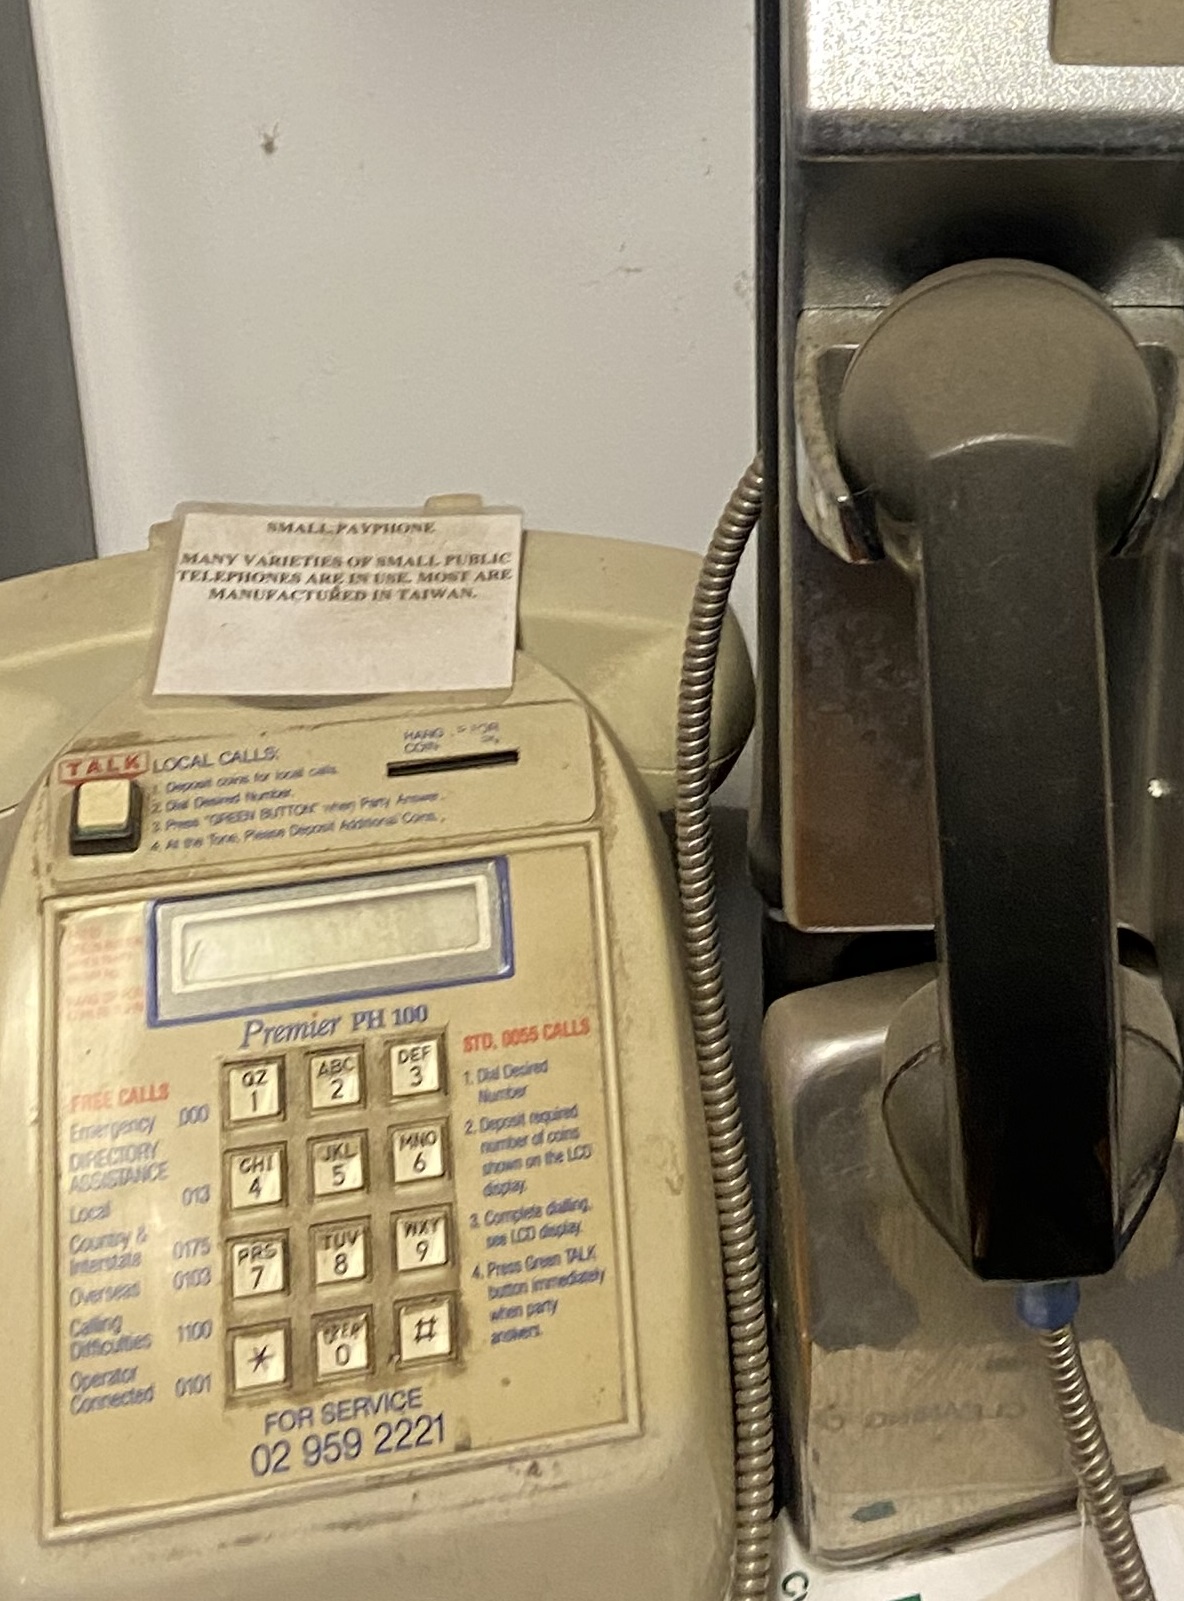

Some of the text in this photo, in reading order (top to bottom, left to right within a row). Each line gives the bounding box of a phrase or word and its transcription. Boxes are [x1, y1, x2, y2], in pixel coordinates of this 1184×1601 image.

[267, 520, 436, 535] SMALL PAYPHONE
[181, 552, 512, 568] MANY VARIETIES OF SMALL PUBLIC
[177, 570, 302, 584] TELEPHONES
[305, 572, 343, 585] ARE
[349, 572, 369, 584] IN
[416, 570, 468, 583] MOST
[474, 568, 513, 582] ARE
[208, 587, 366, 601] MANUFACTURED
[371, 588, 392, 601] IN
[66, 754, 142, 777] TALK
[153, 754, 214, 775] LOCAL
[239, 1004, 429, 1050] Premier PH 100
[264, 1386, 422, 1436] FOR SERVICE
[251, 1410, 445, 1477] 02 959 2221
